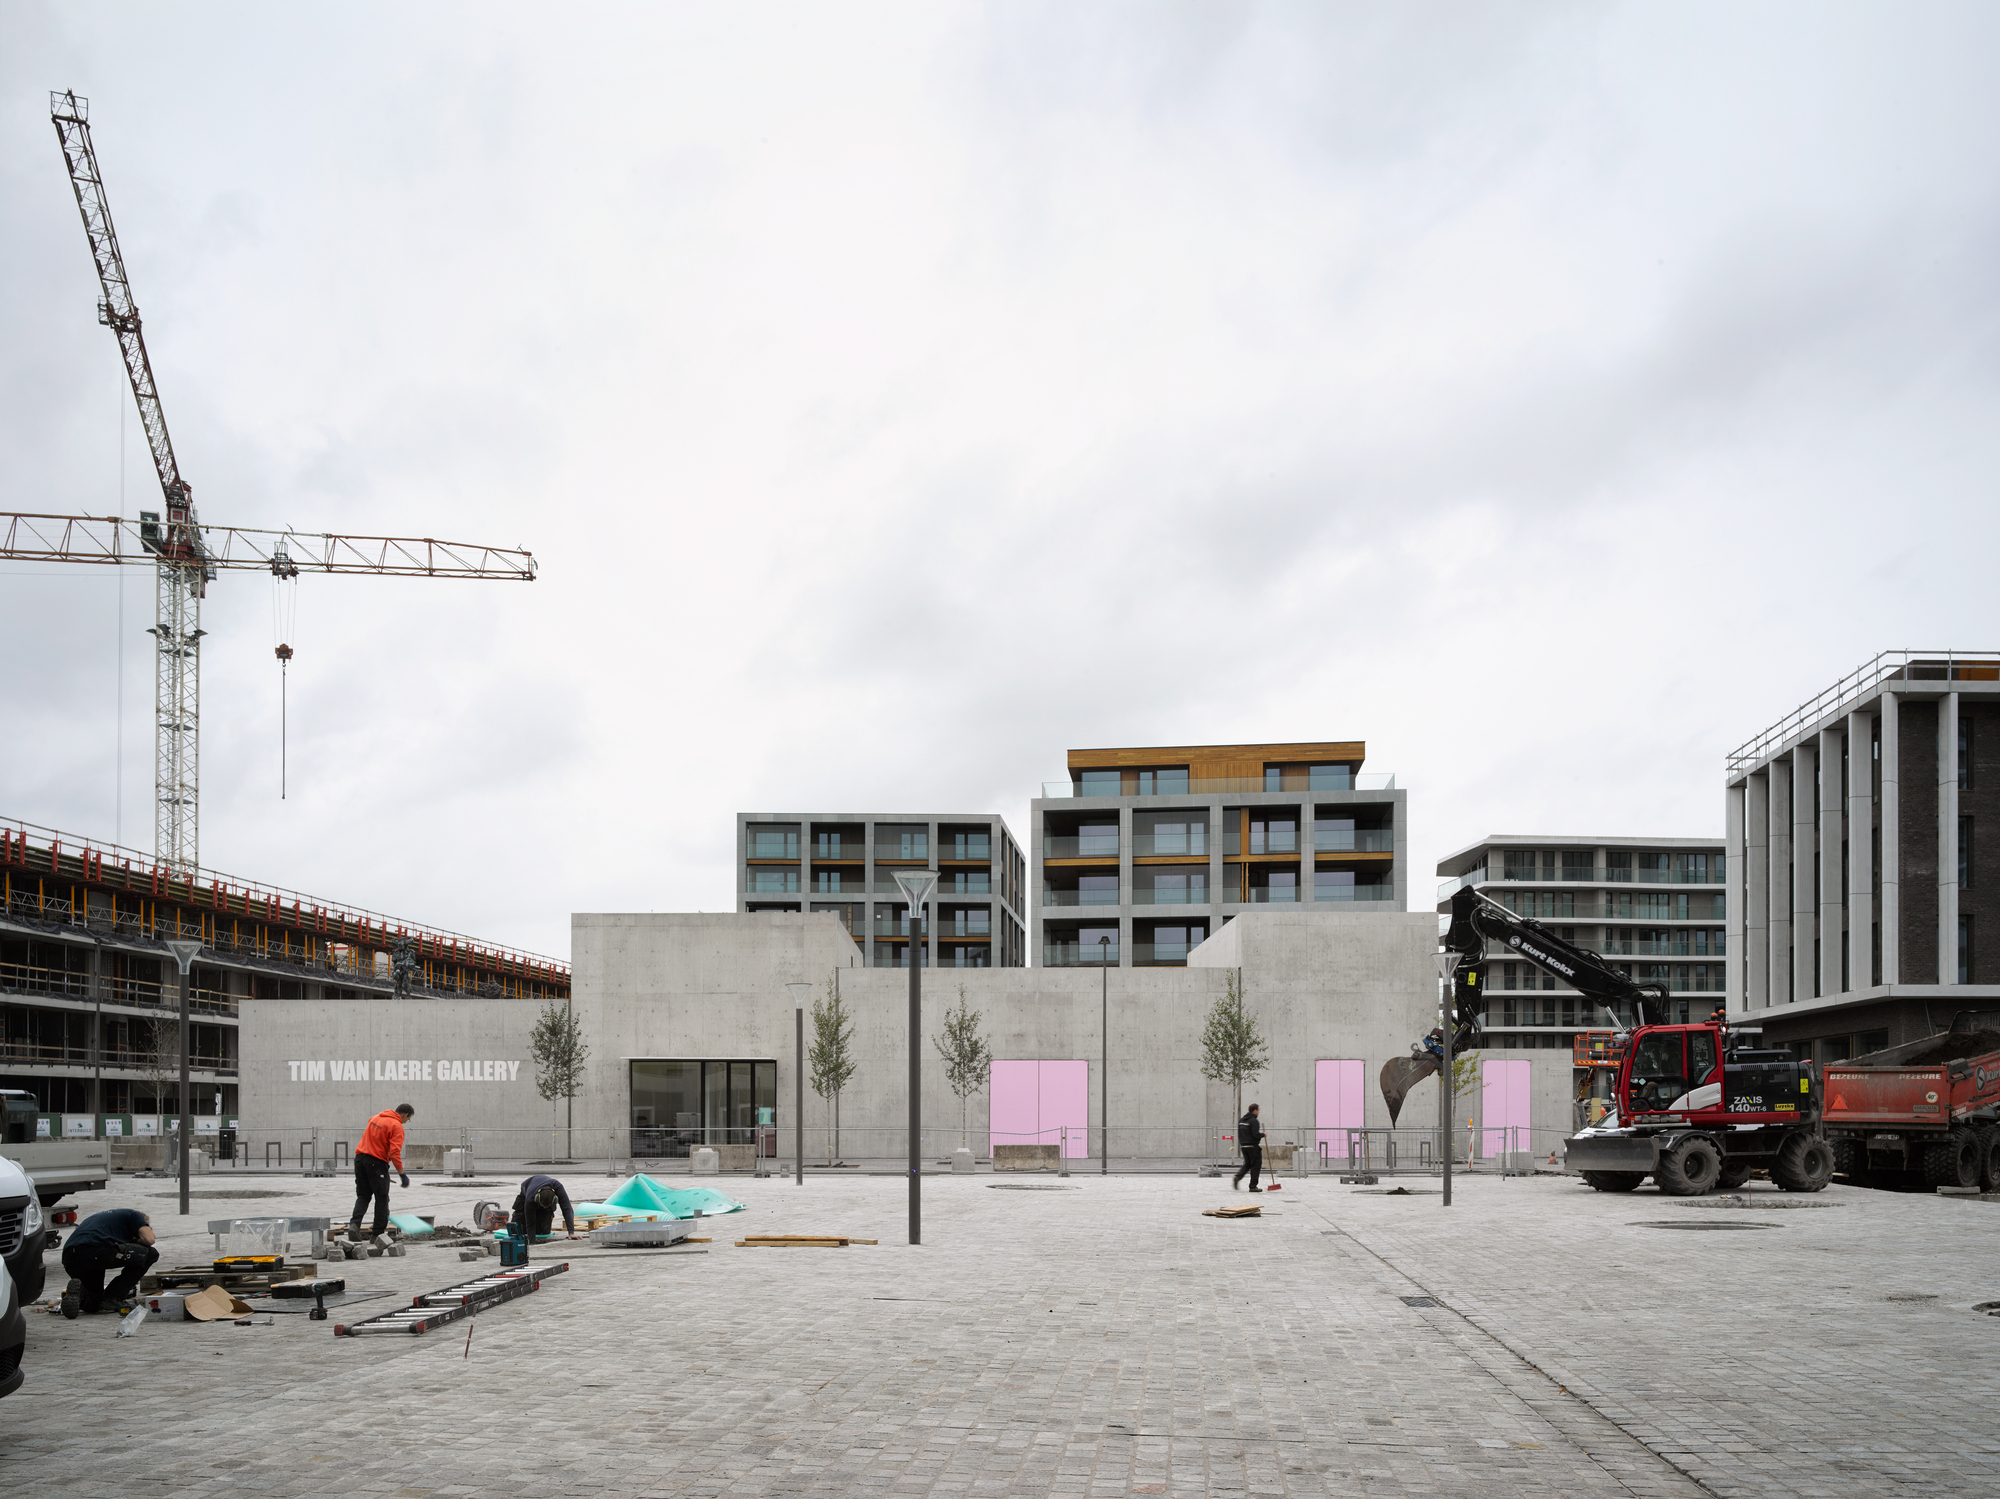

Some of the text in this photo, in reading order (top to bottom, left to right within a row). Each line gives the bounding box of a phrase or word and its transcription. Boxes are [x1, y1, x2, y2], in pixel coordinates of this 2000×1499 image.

[1521, 942, 1547, 960] Kurt
[288, 1060, 520, 1081] TIM VAN LAERE GALLERY
[1733, 1095, 1763, 1104] ZAXIS
